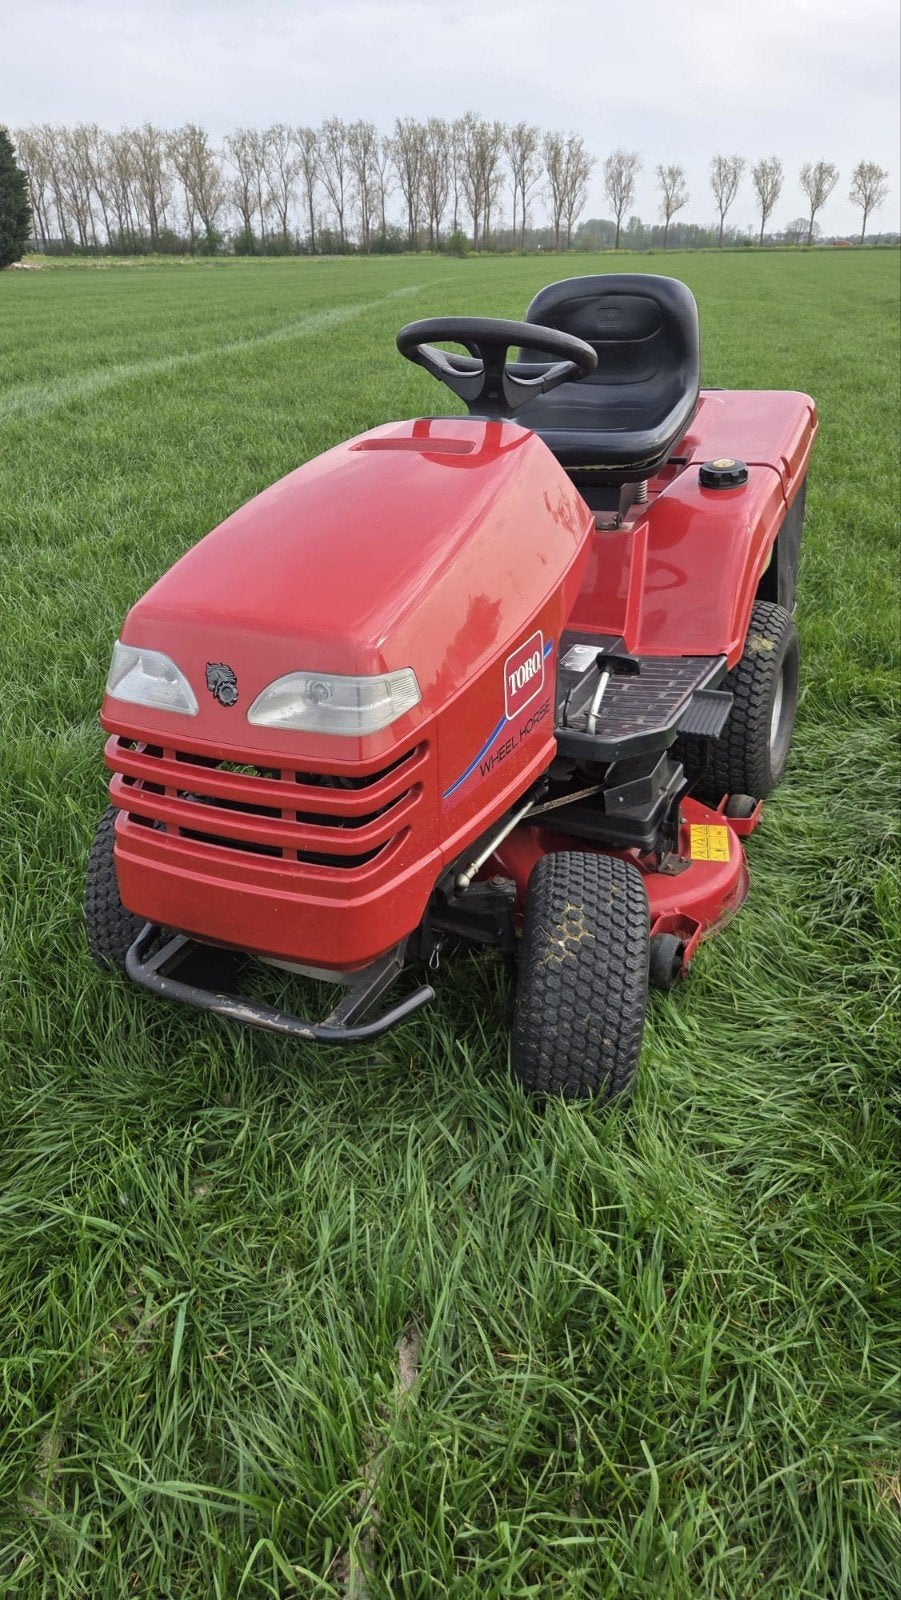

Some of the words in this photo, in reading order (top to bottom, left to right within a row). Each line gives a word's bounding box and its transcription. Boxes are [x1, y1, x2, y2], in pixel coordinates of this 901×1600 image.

[508, 651, 542, 697] TORO
[479, 738, 518, 777] WHEEL
[519, 699, 551, 740] HORSE
